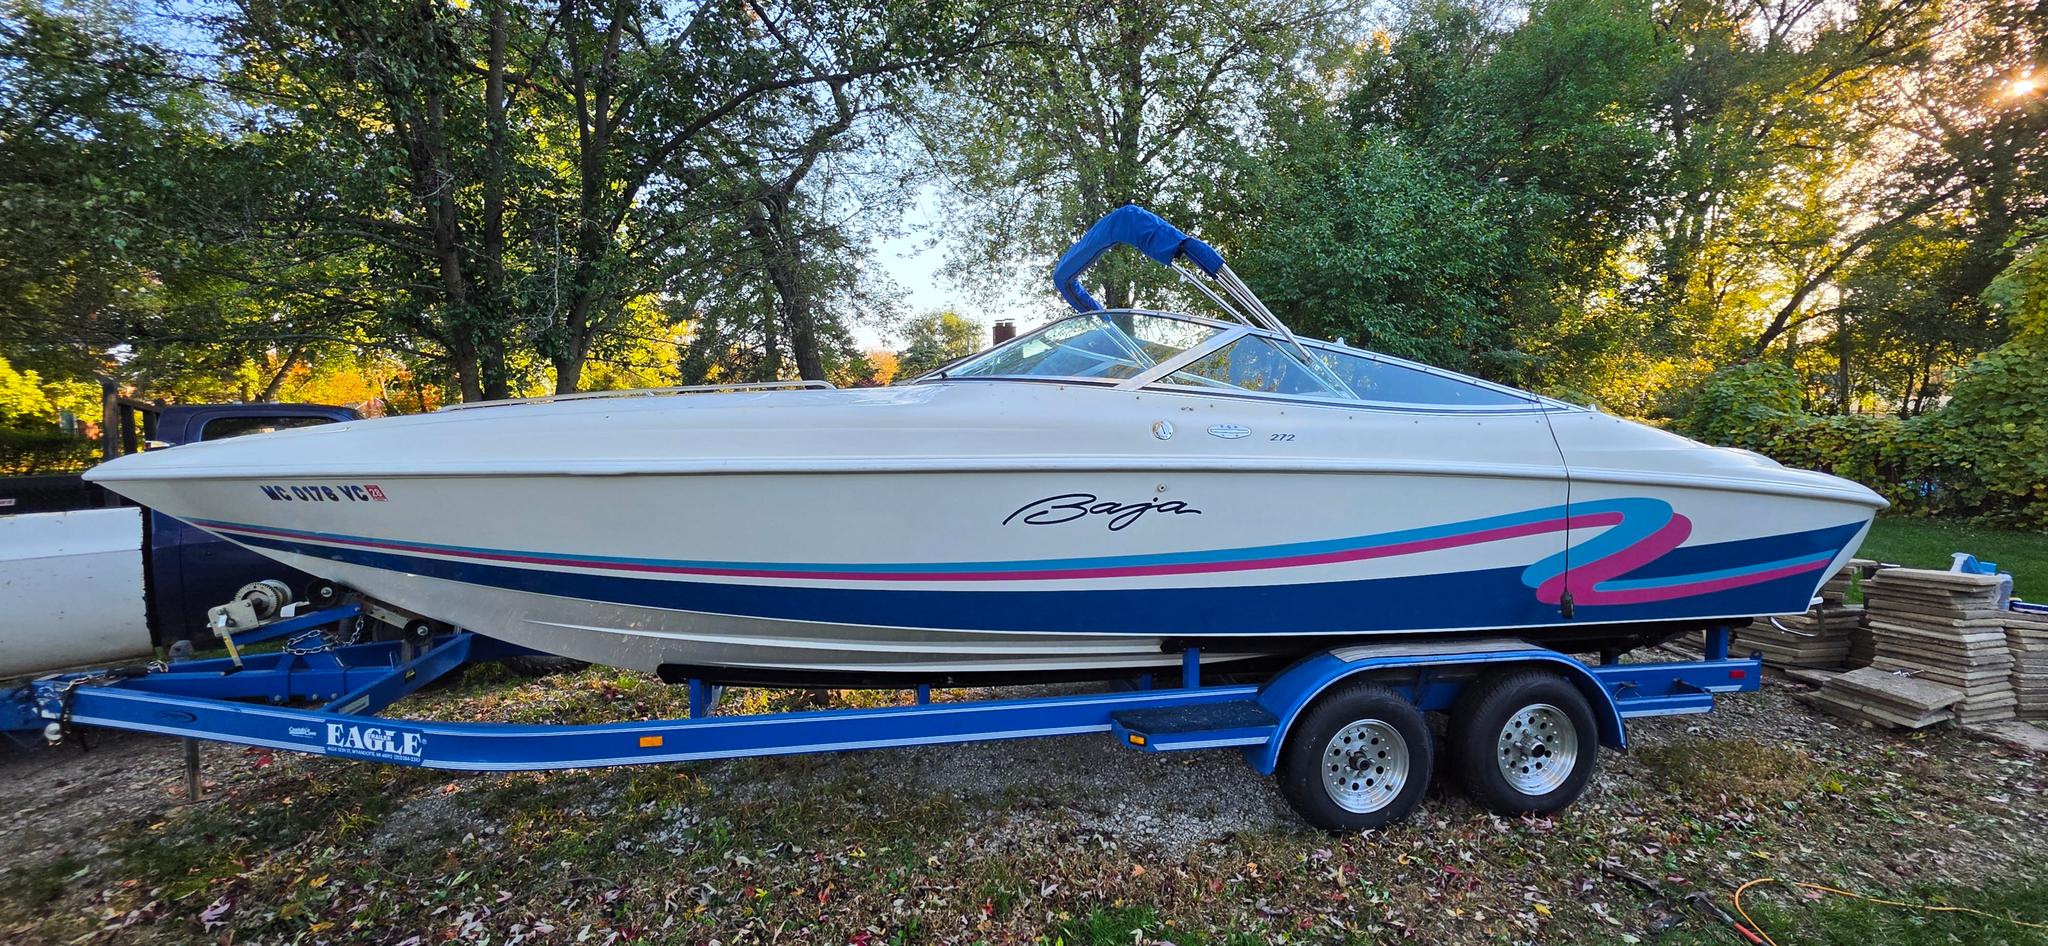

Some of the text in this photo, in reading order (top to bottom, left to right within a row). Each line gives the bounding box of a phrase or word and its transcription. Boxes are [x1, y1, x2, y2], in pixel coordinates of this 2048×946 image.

[1270, 433, 1296, 441] 272
[260, 485, 292, 501] MC
[337, 485, 369, 501] VC
[1002, 493, 1202, 531] Baja
[326, 723, 423, 758] EAGLE
[368, 732, 392, 741] TRAILER
